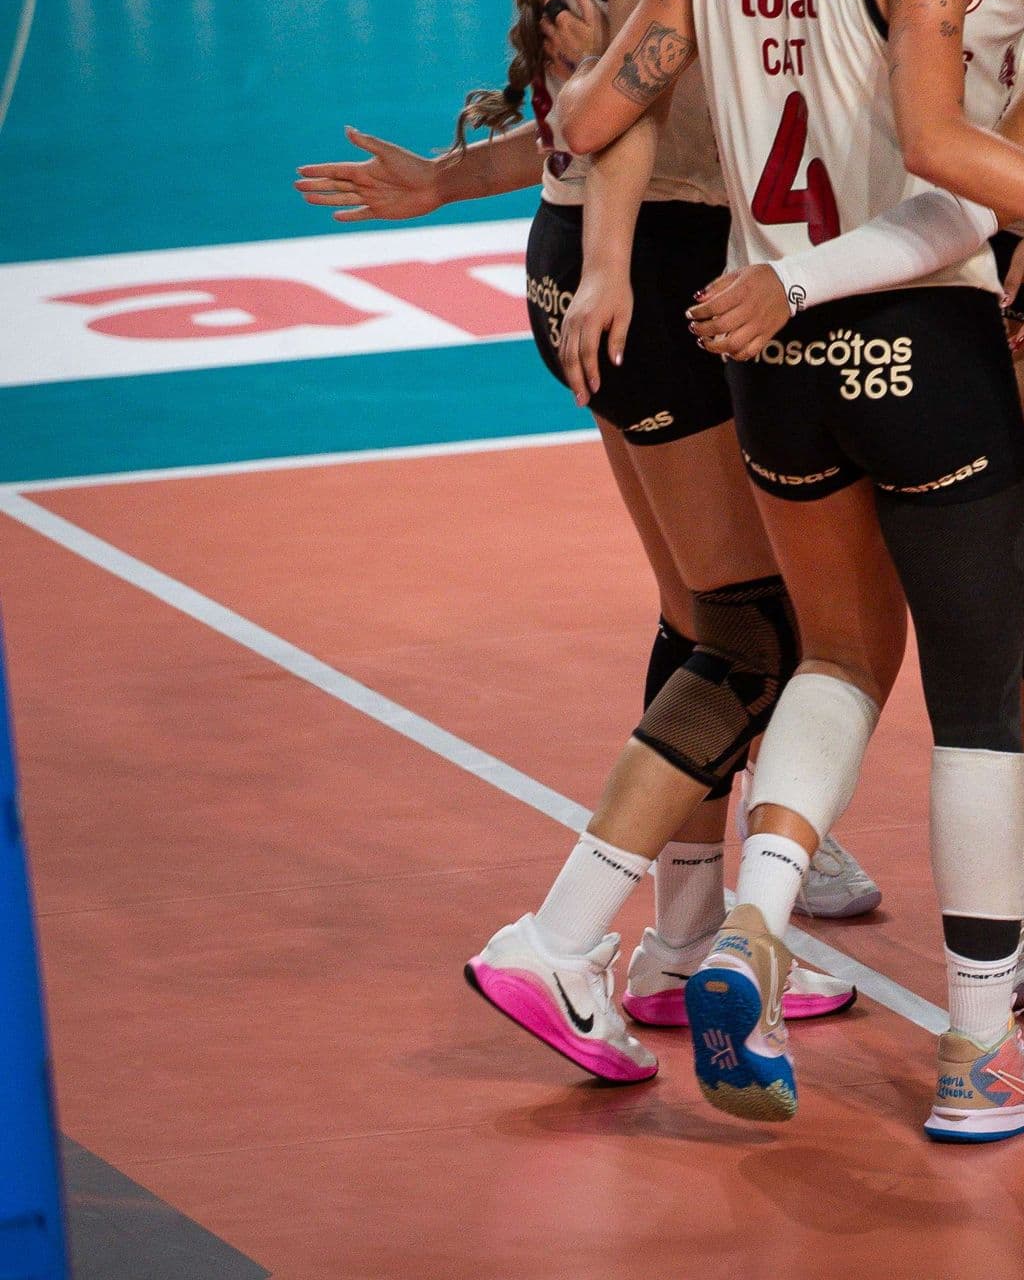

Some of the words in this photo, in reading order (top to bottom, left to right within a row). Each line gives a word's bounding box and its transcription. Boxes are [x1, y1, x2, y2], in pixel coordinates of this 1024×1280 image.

[762, 37, 806, 77] CAT
[751, 91, 842, 247] 4
[721, 328, 913, 367] ascotas
[839, 364, 914, 401] 365
